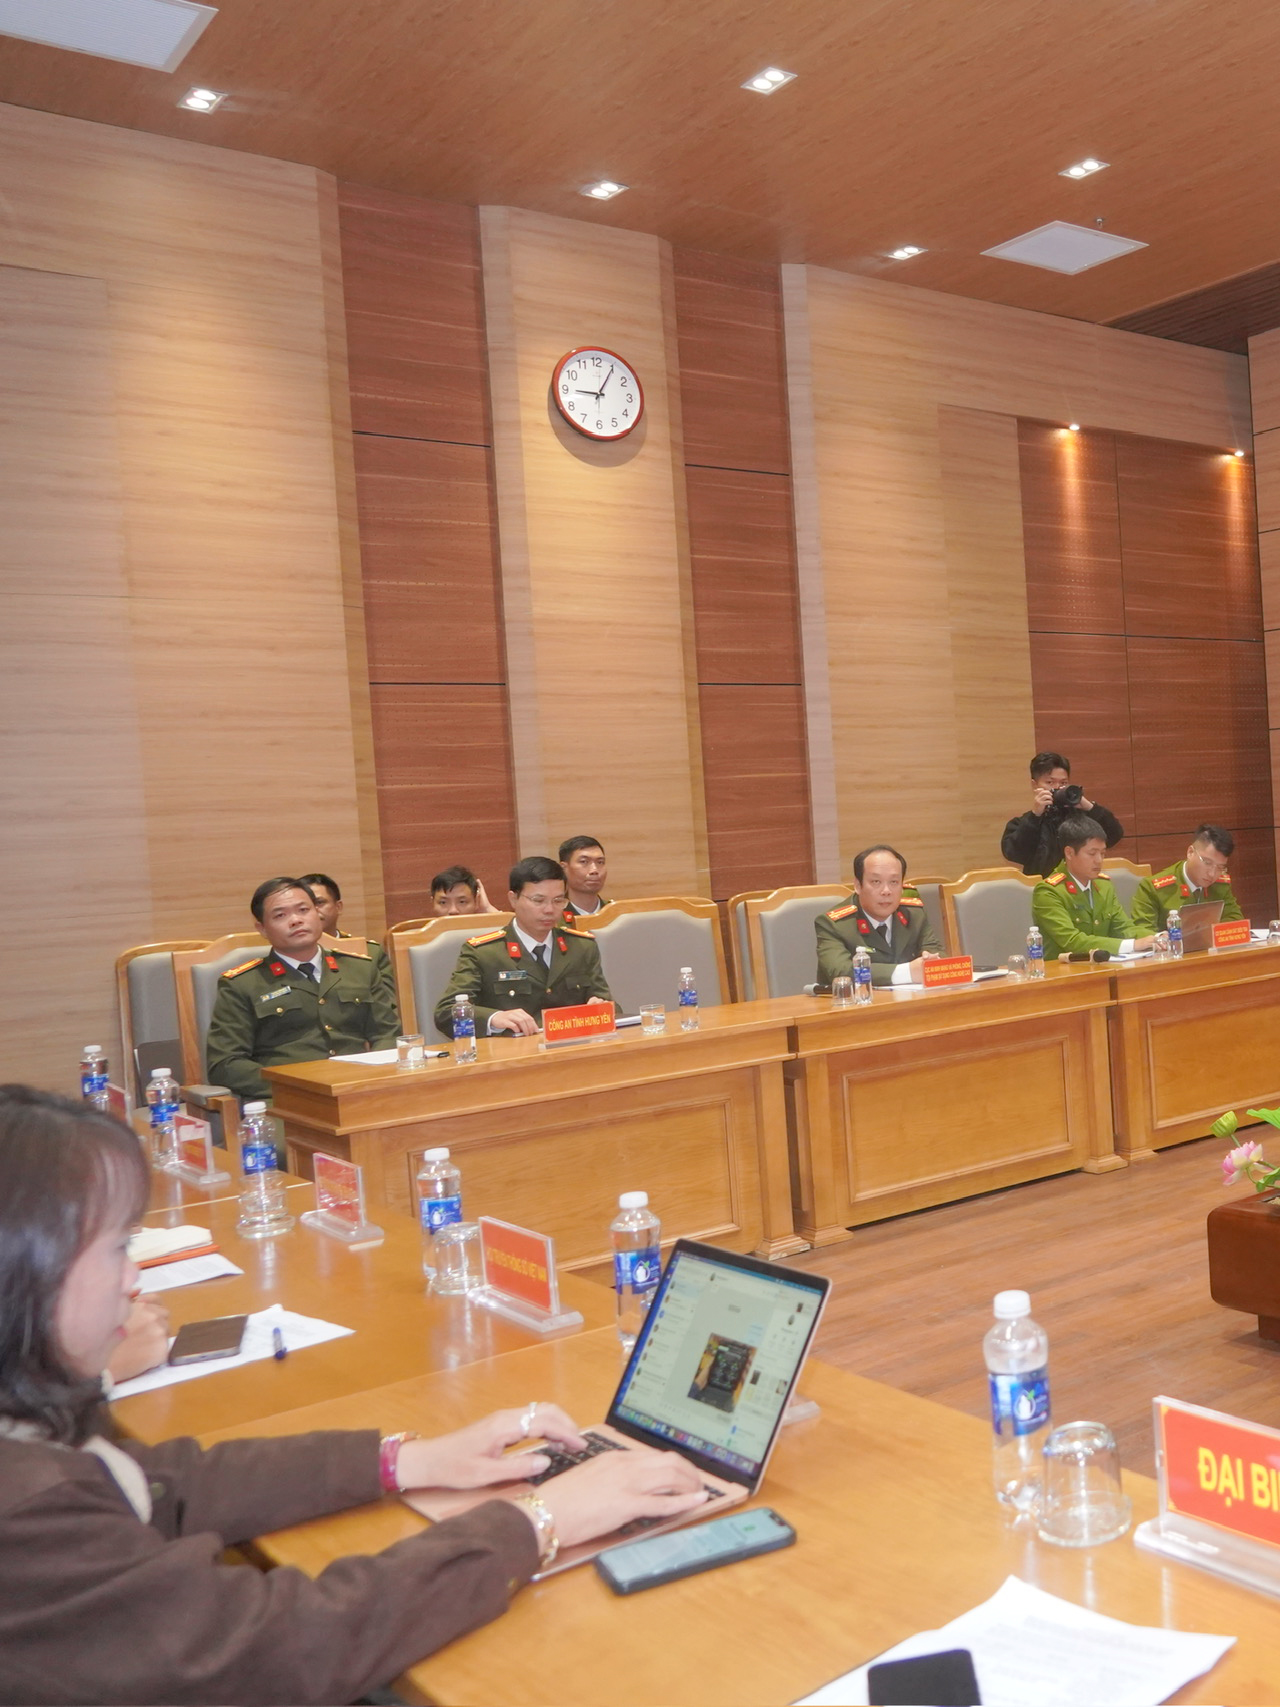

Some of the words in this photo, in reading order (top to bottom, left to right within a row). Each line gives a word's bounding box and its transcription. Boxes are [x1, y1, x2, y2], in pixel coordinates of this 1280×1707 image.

[577, 359, 587, 370] 11
[591, 357, 602, 368] 12
[566, 369, 578, 381] 10
[620, 376, 628, 387] 2
[562, 384, 569, 394] 9
[626, 393, 633, 404] 3
[568, 401, 575, 411] 8
[580, 413, 588, 423] 7
[622, 408, 629, 418] 4
[596, 419, 603, 430] 6
[611, 417, 618, 428] 5
[548, 1018, 564, 1031] CÔNG
[564, 1020, 572, 1030] AN
[585, 1015, 600, 1026] HƯNG
[600, 1012, 611, 1024] YÊN
[1197, 1446, 1245, 1507] ĐẠI
